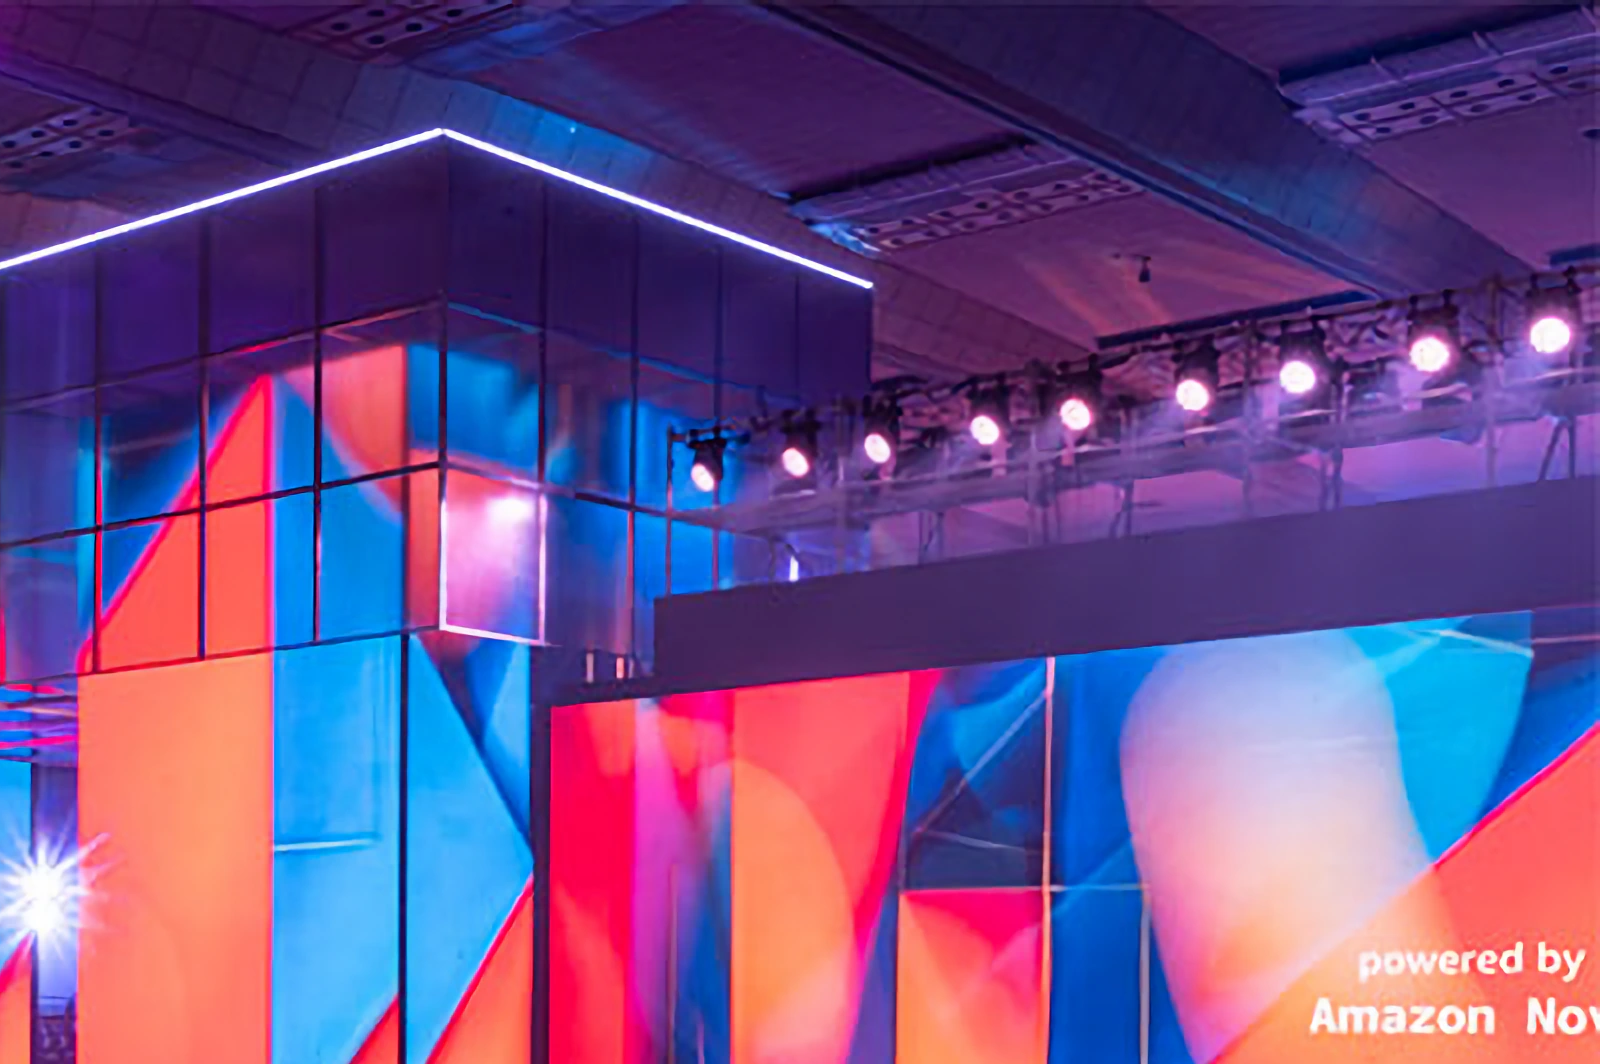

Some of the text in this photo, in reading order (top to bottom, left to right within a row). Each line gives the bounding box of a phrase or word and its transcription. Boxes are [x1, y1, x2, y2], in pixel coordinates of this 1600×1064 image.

[1358, 941, 1586, 983] powered by
[1309, 997, 1495, 1035] Amazon
